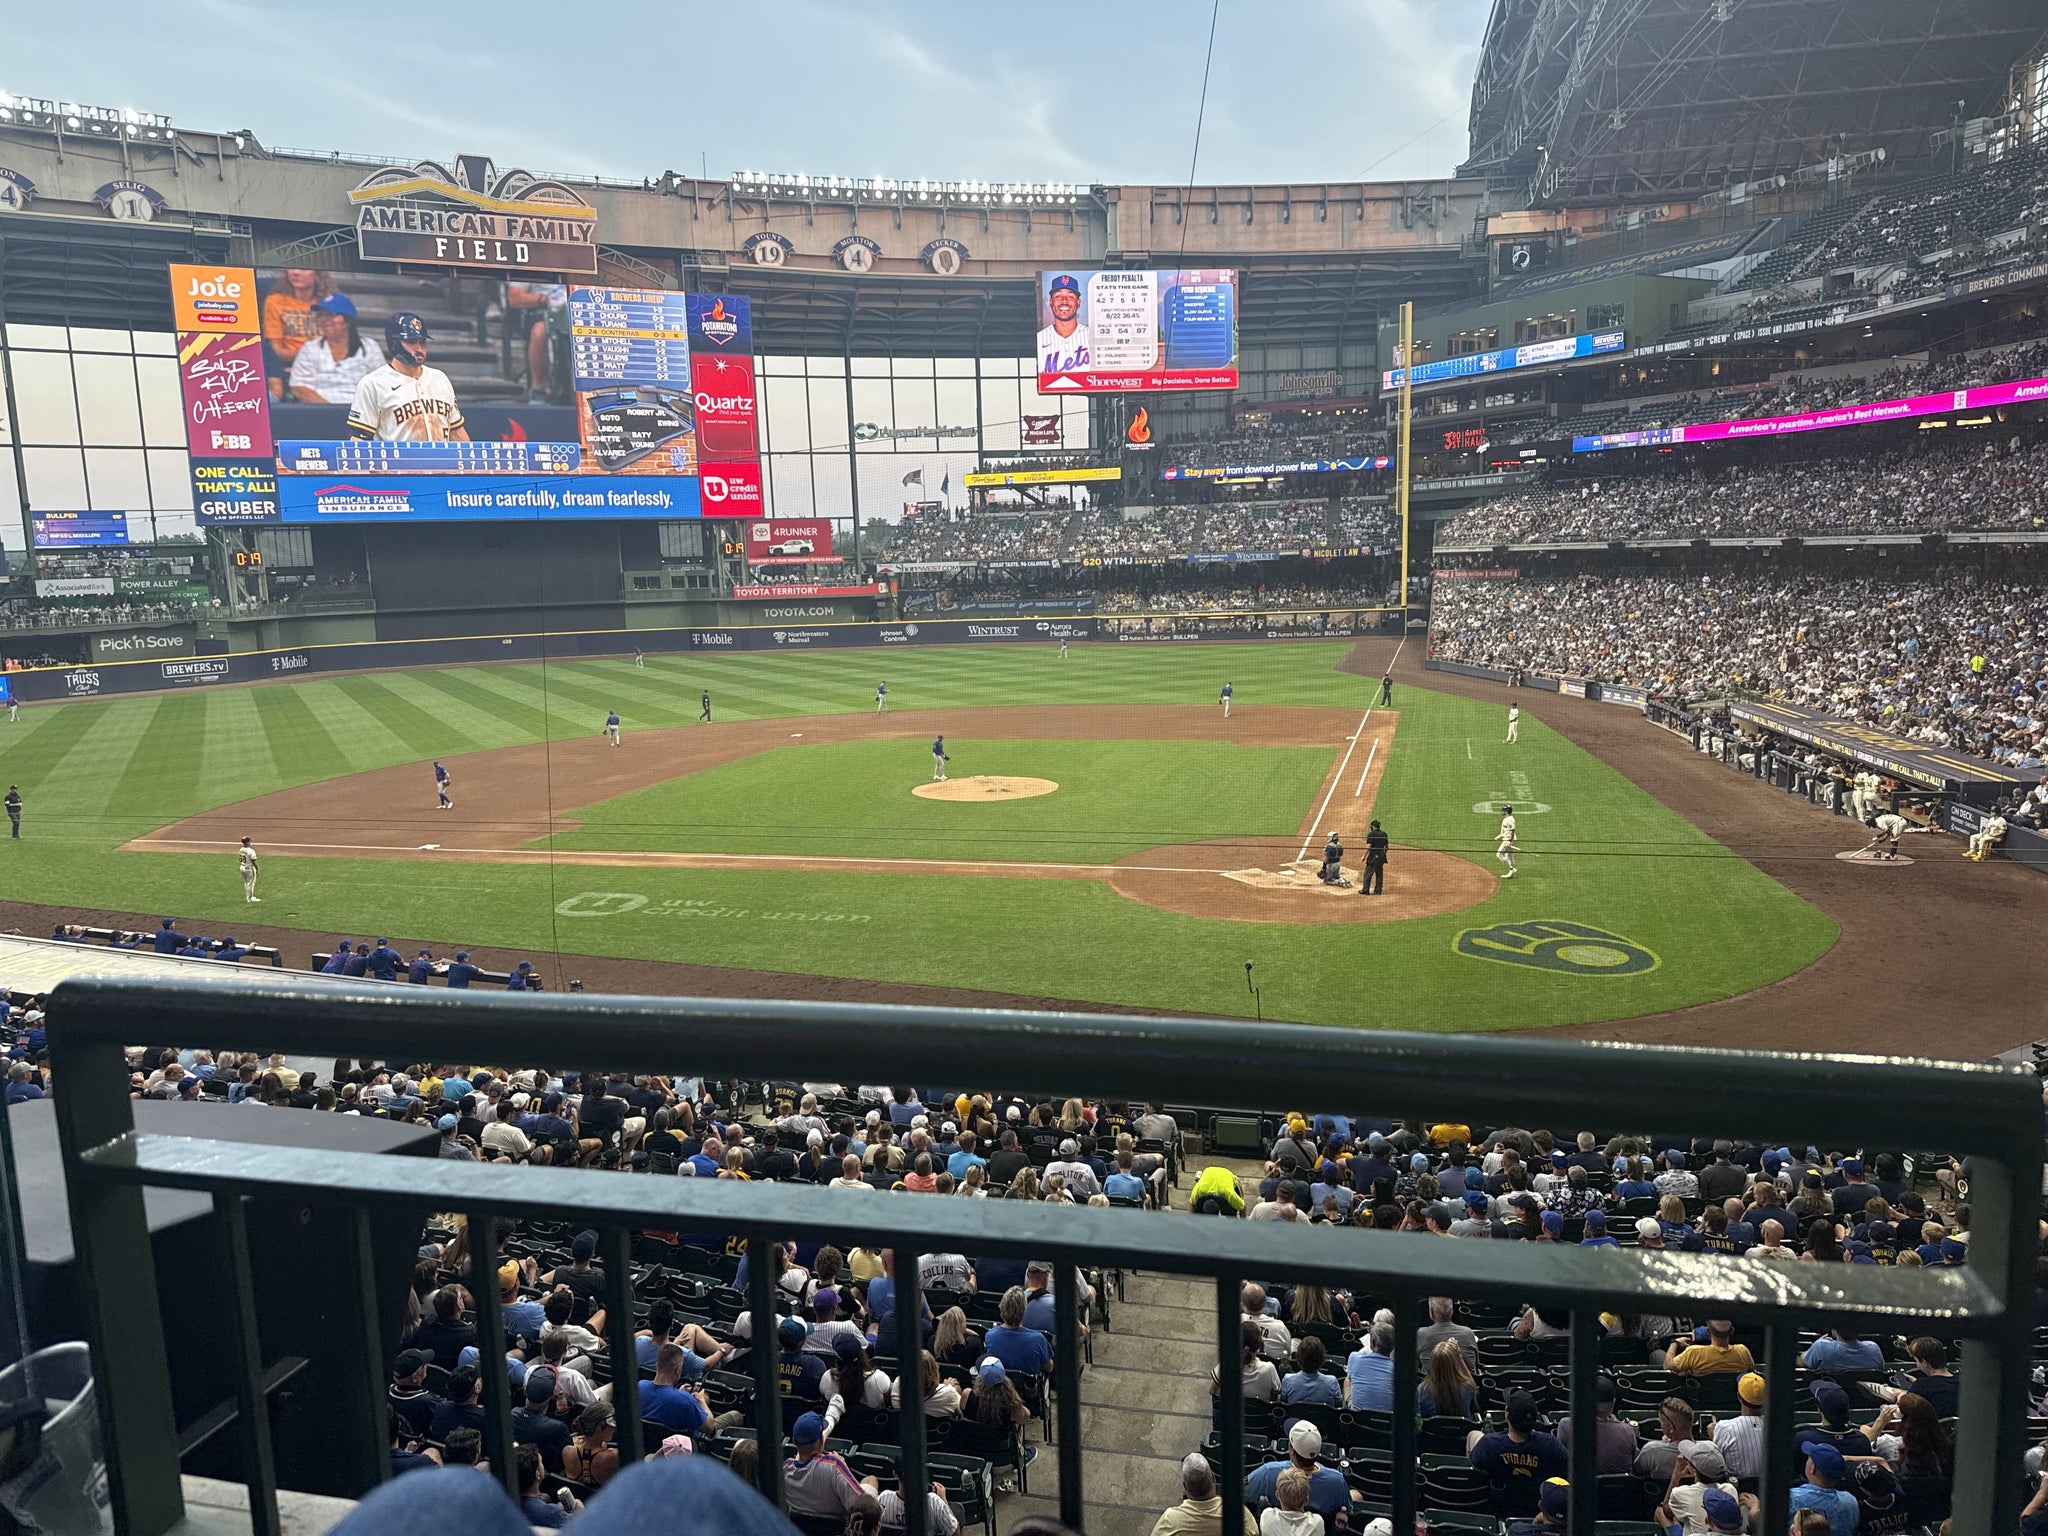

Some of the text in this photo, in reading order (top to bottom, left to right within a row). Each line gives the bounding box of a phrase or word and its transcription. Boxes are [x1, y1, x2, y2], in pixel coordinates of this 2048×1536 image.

[112, 181, 146, 192] SELIG
[361, 206, 593, 243] AMERICAN FAMILY
[755, 233, 782, 242] YOUNT
[840, 237, 875, 248] MOLITOR
[436, 237, 530, 263] FIELD
[930, 240, 959, 249] UECKER
[758, 246, 780, 262] 19
[851, 250, 862, 265] 4
[1101, 274, 1144, 282] FREDDY PERALTA
[1968, 275, 2005, 293] BREWERS
[188, 275, 241, 298] Joie
[611, 292, 665, 303] BREWERS LINEUP
[601, 329, 640, 337] CONTRERAS
[702, 322, 737, 333] POTAWATOMI
[1757, 322, 1806, 337] ISSUE AND LOCATION
[1044, 346, 1090, 372] Mets
[187, 359, 249, 379] BOLD
[200, 370, 261, 393] KICK
[1280, 371, 1342, 390] Johnsonville
[695, 392, 753, 413] Quartz
[193, 398, 261, 424] CHERRY
[1728, 404, 1911, 434] America's pastime. America's Best Network.
[300, 448, 321, 458] METS
[295, 460, 328, 471] BREWERS
[1184, 461, 1318, 478] Stay away from downed power lines
[195, 467, 273, 479] ONE CALL...
[196, 482, 276, 493] THAT'S ALL!
[729, 484, 757, 492] credit
[318, 496, 408, 504] AMERICAN FAMILY
[446, 490, 673, 509] Insure carefully, dream fearlessly.
[730, 491, 759, 500] union
[200, 501, 276, 515] GRUBER
[774, 528, 818, 536] 4RUNNER
[1313, 548, 1359, 558] NICOLET LAW
[1083, 558, 1102, 566] 620
[1103, 557, 1133, 565] WTMJ
[120, 580, 178, 589] POWER ALLEY
[736, 587, 818, 596] TOYOTA TERRITORY
[764, 607, 834, 618] TOYOTA.COM
[788, 630, 829, 638] Northwestern
[968, 626, 1019, 635] WINTRUST
[147, 636, 184, 648] Save
[702, 634, 732, 645] Mobile
[281, 655, 308, 669] Mobile
[166, 662, 224, 675] BREWERS.TV
[64, 673, 100, 688] TRUSS
[1889, 762, 1899, 774] ONE
[1951, 806, 1959, 815] ON
[642, 907, 872, 922] credit union
[1704, 1238, 1735, 1251] TURANG
[922, 1265, 954, 1279] COLLINS
[1500, 1452, 1539, 1468] TURANG
[1868, 1511, 1909, 1531] FRELICK
